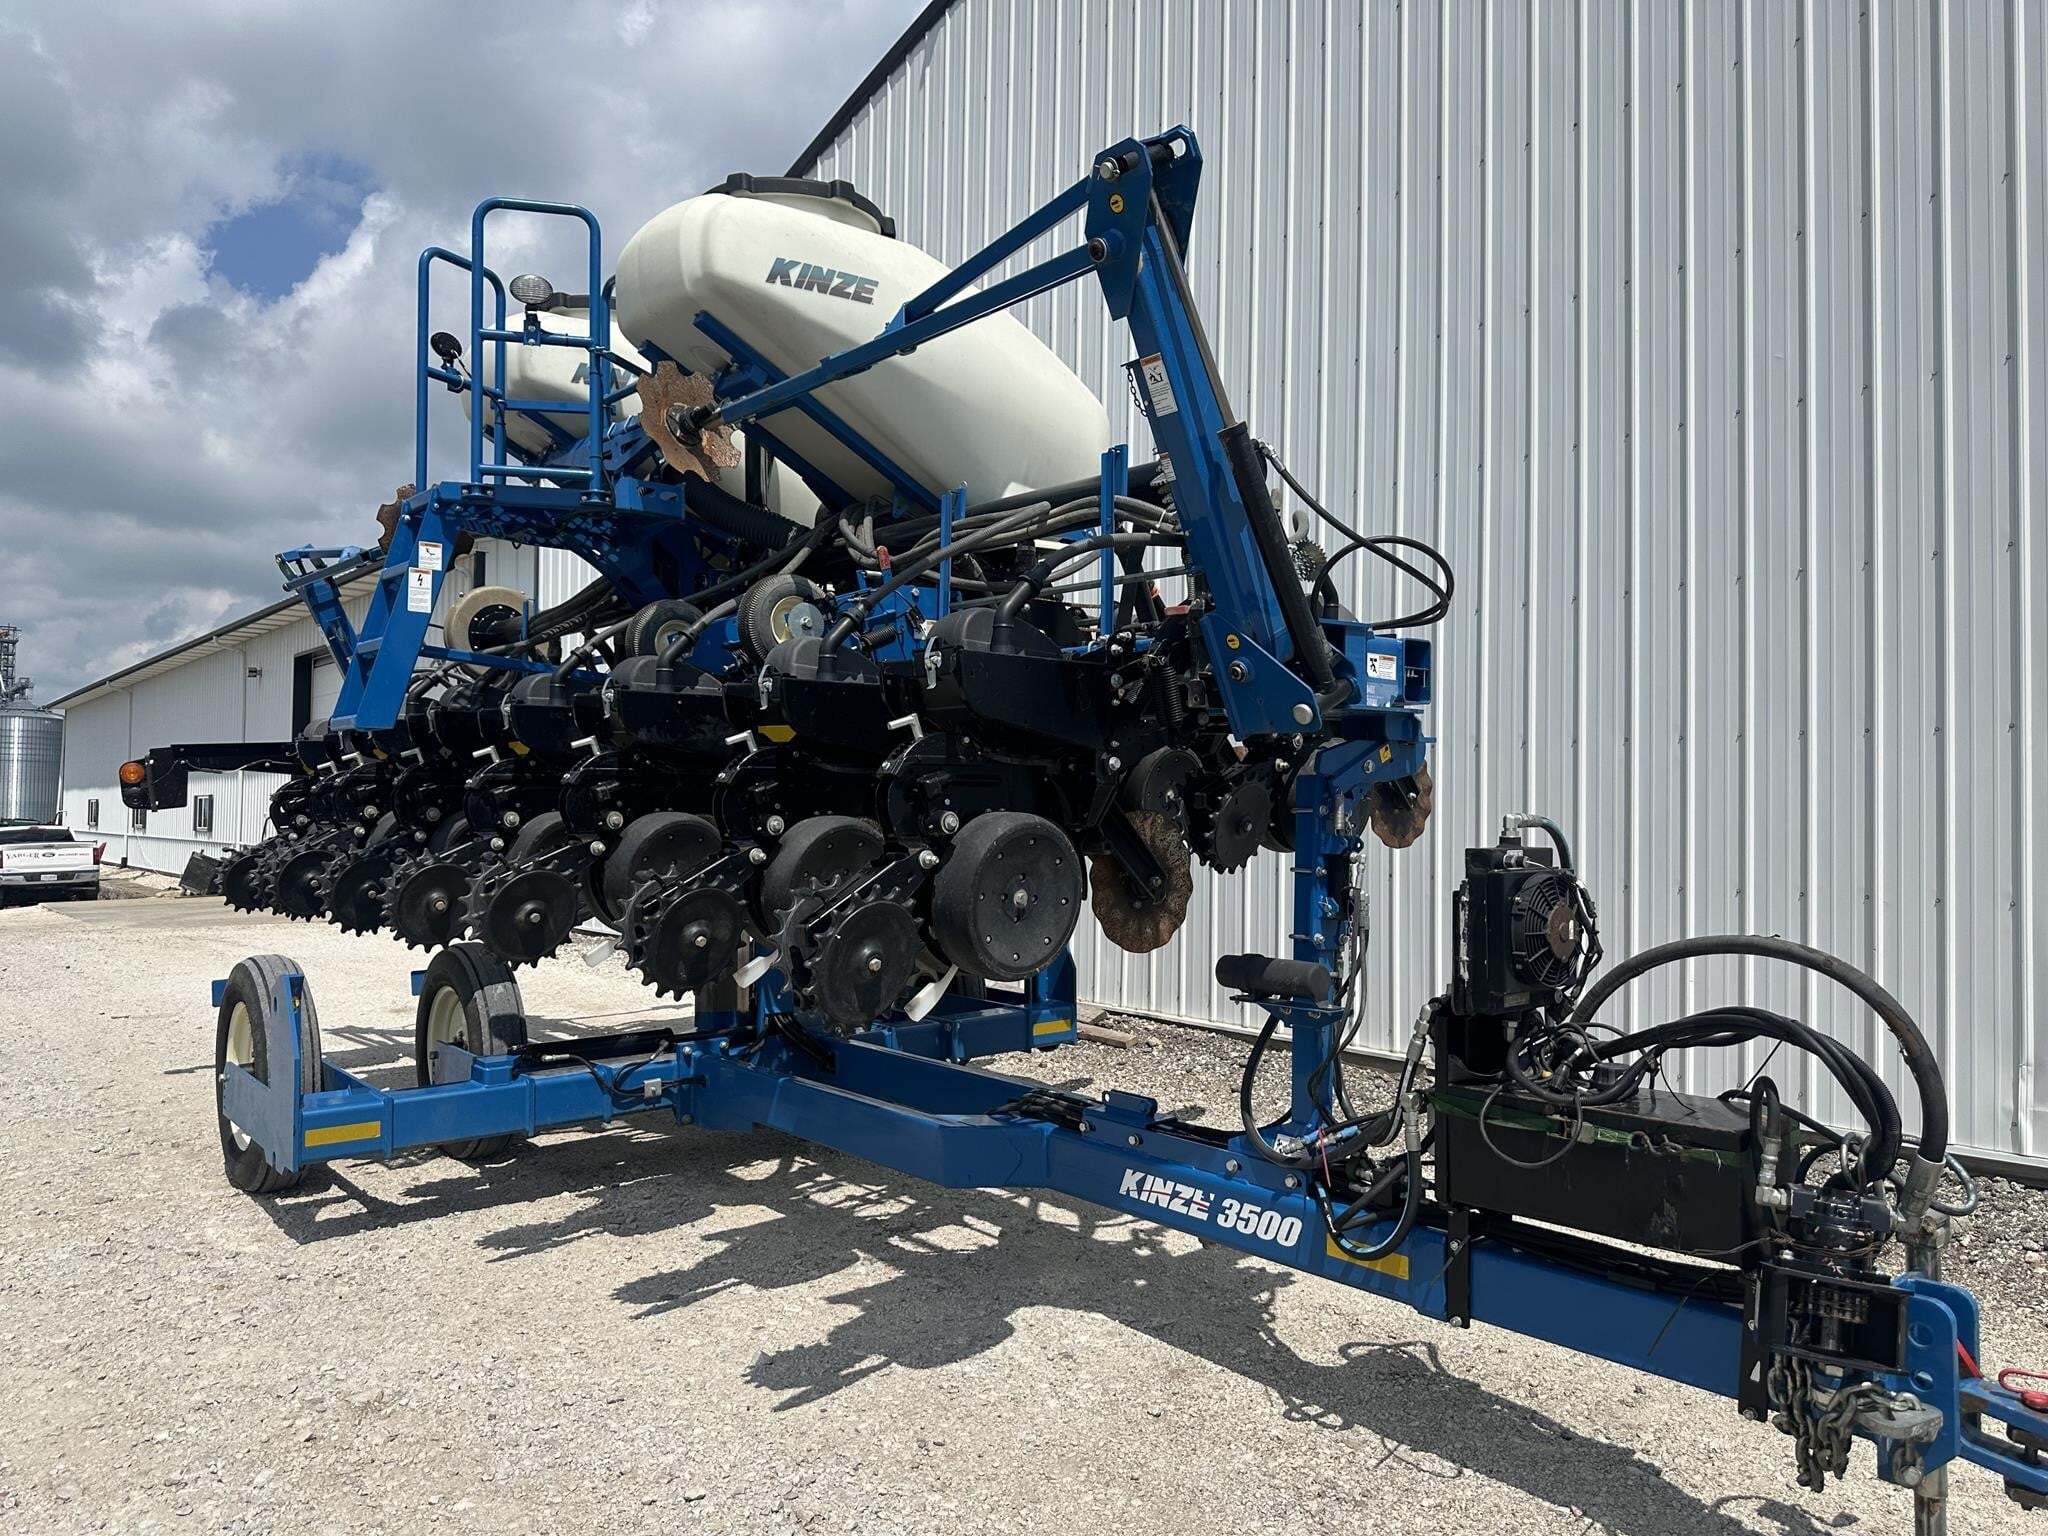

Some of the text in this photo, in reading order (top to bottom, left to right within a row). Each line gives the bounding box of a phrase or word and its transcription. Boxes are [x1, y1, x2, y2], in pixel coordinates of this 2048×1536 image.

[765, 257, 879, 305] KINZE
[1118, 1168, 1303, 1247] KINZE 3500
